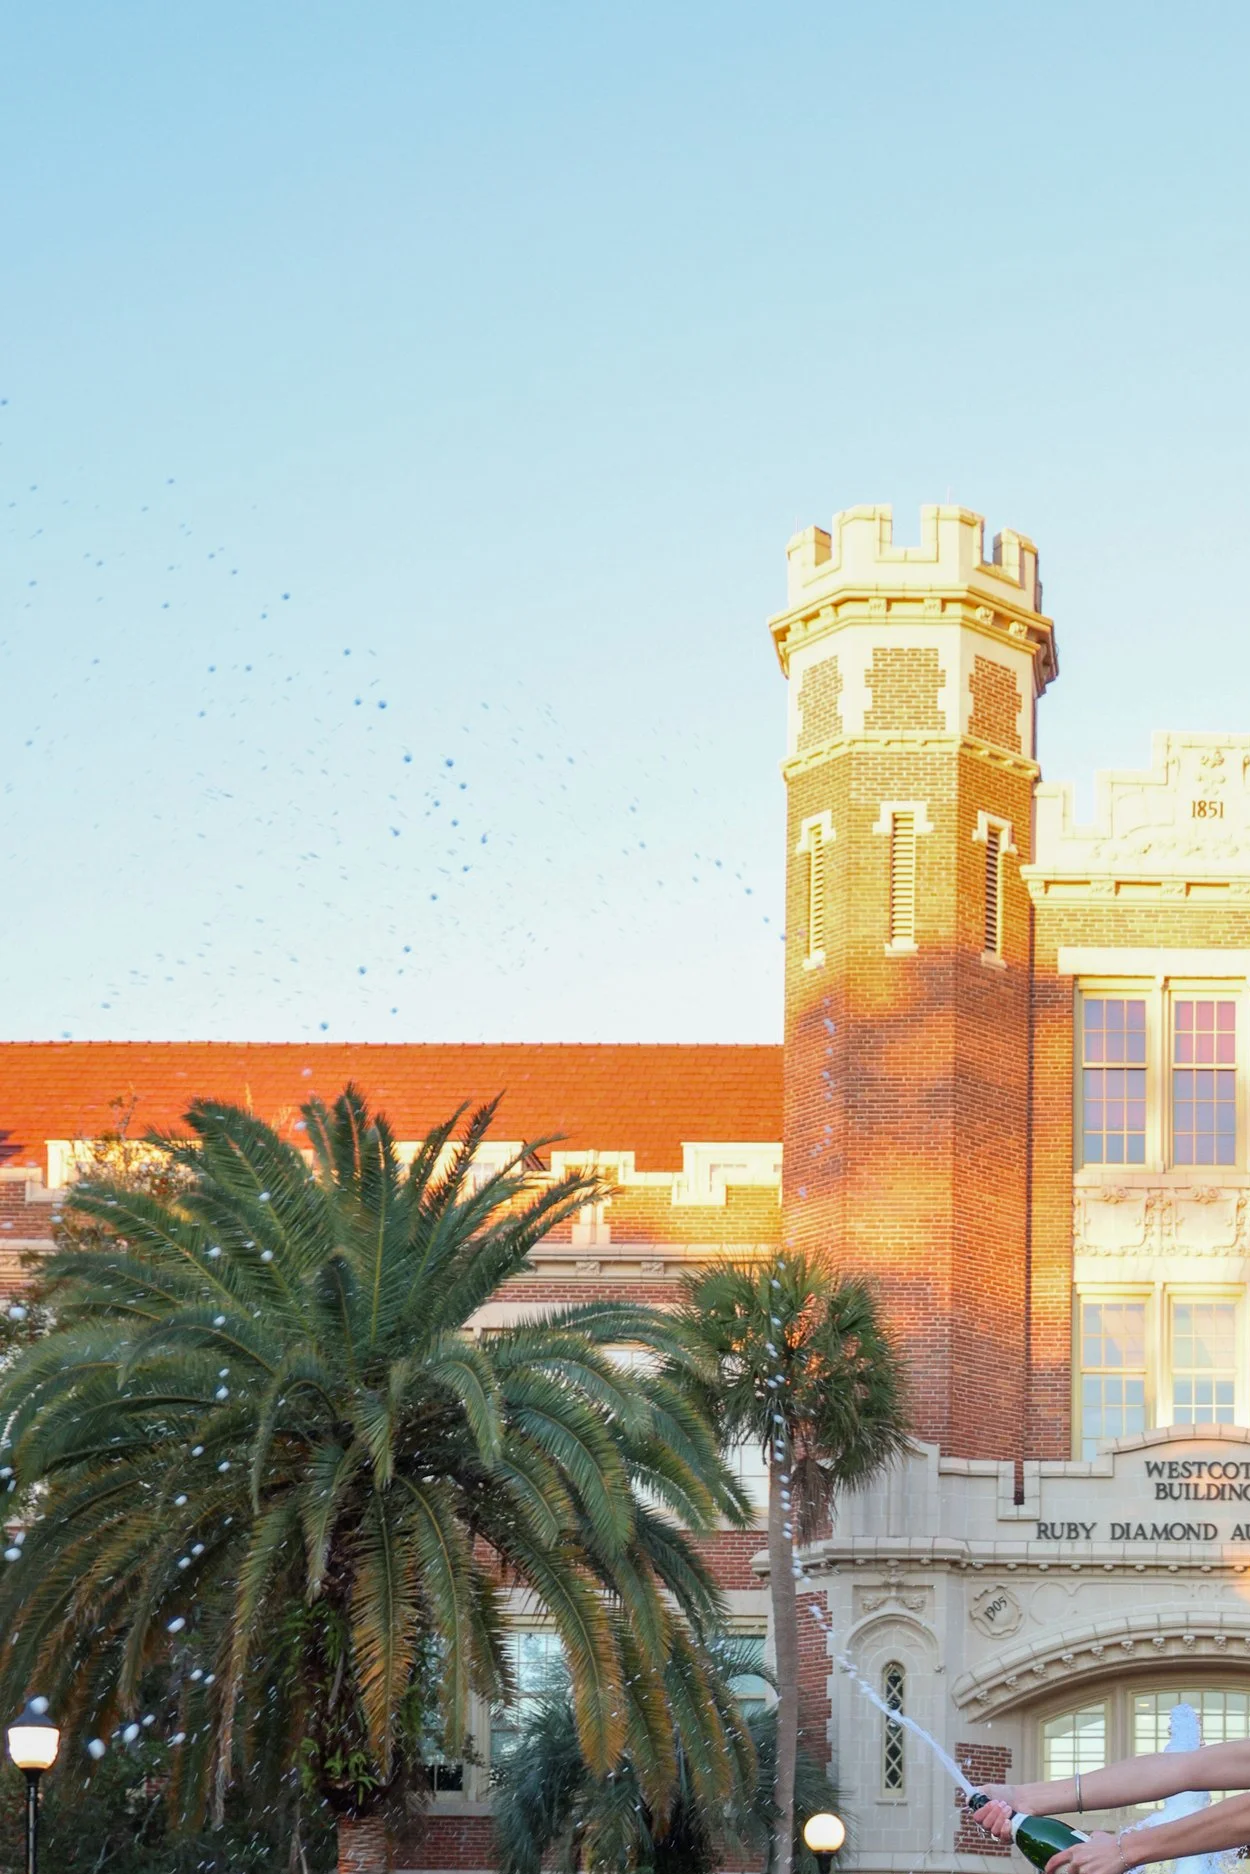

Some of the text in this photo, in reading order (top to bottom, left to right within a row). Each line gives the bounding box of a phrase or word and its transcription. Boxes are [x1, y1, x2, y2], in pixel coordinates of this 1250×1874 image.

[1191, 799, 1225, 819] 1851
[1036, 1521, 1097, 1541] RUBY
[1110, 1522, 1218, 1542] DIAMOND
[983, 1595, 1008, 1623] 1905
